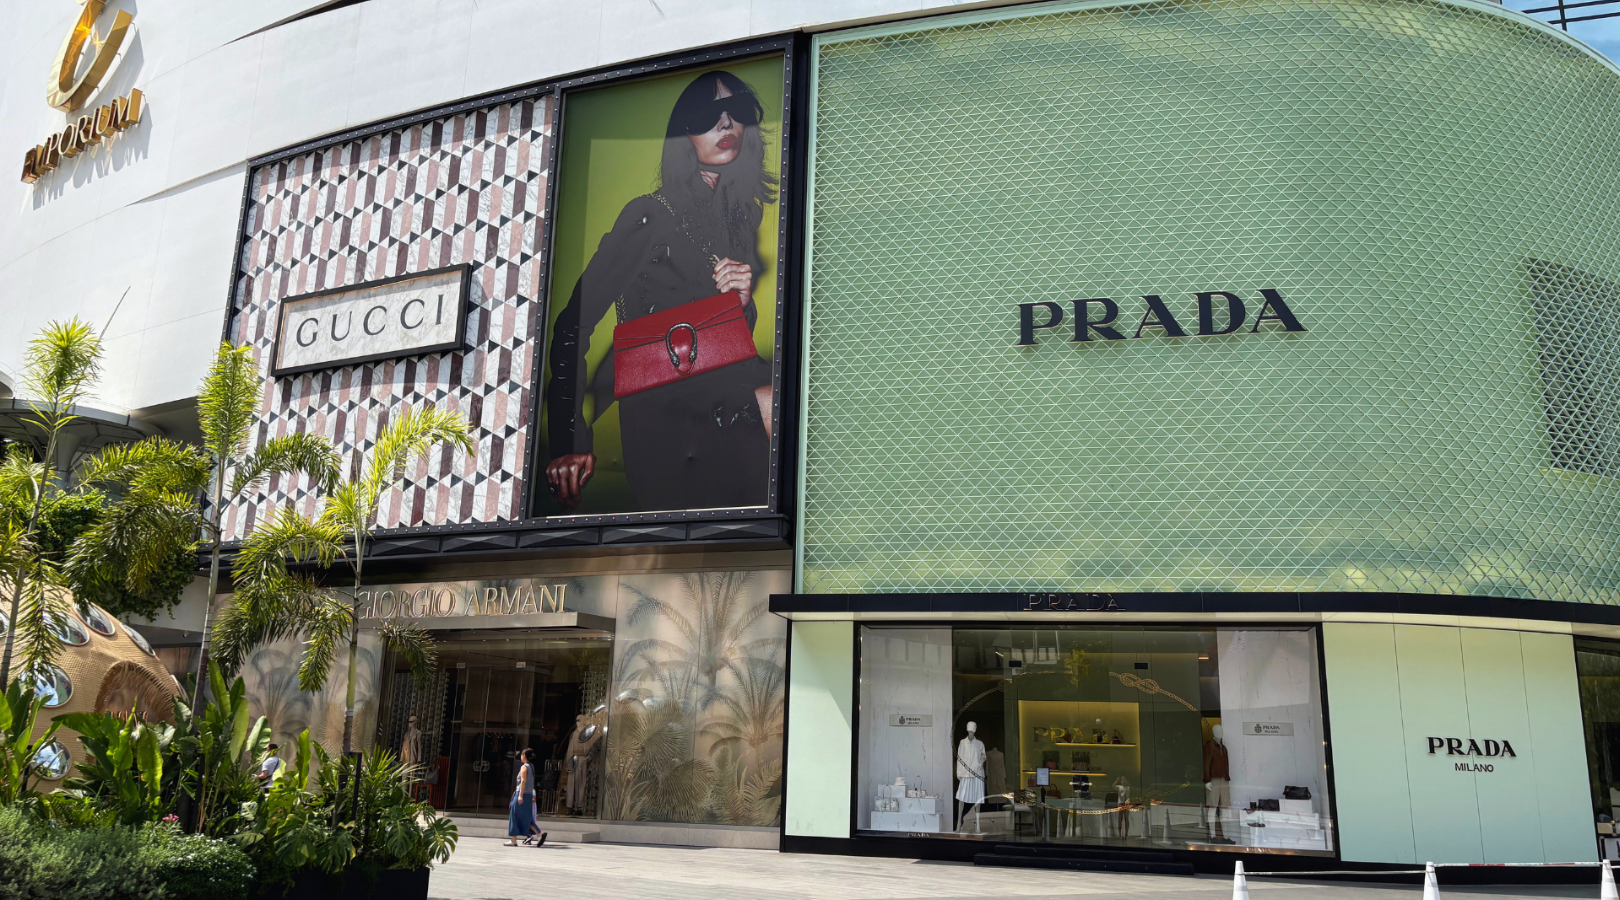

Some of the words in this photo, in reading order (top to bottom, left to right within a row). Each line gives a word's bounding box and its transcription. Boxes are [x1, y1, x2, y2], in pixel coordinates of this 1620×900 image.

[296, 294, 444, 348] GUCCI
[1015, 288, 1309, 347] PRADA
[357, 588, 457, 618] GIORGIO
[464, 584, 568, 616] ARMANI
[1023, 593, 1126, 611] PRADA
[1427, 736, 1517, 758] PRADA
[1454, 763, 1494, 773] MILANO
